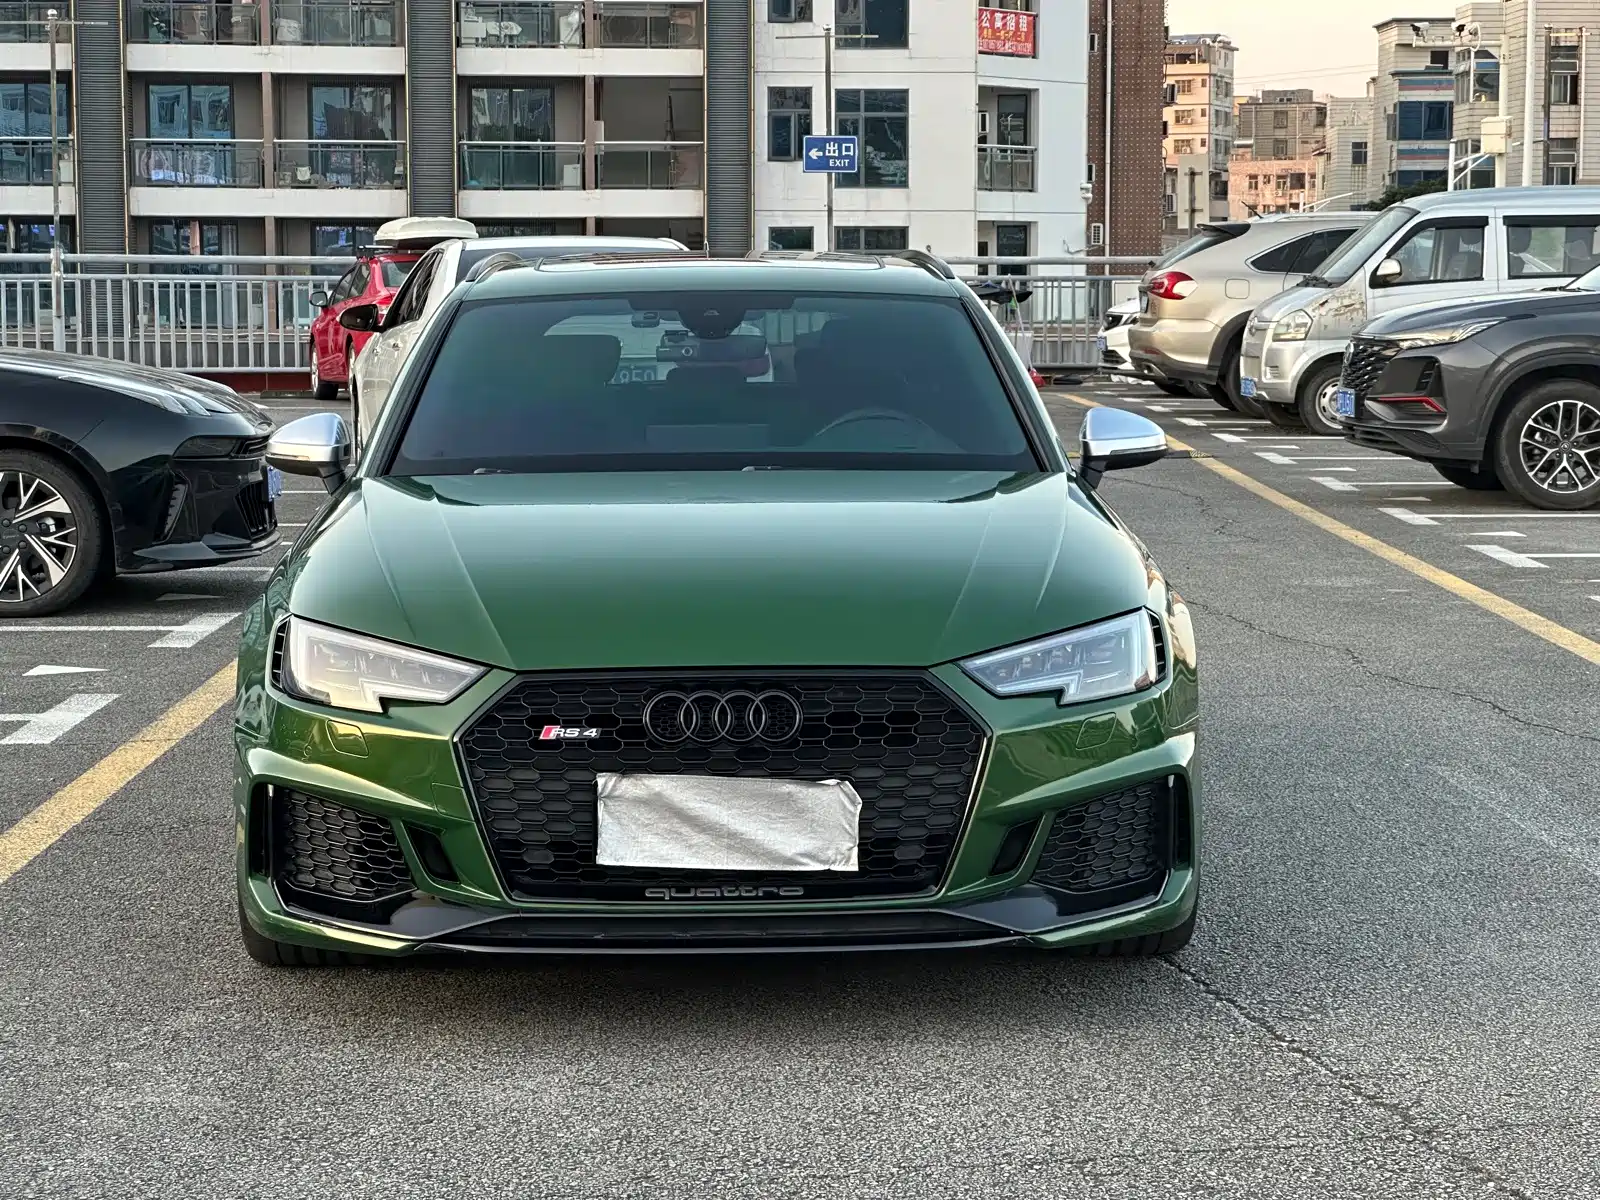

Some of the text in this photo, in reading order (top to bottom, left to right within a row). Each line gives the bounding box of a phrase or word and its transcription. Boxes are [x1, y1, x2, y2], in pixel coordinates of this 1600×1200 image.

[982, 11, 1028, 31] 公寓招租
[825, 142, 854, 157] 出口
[829, 159, 850, 167] EXIT
[545, 726, 598, 739] RS 4
[644, 886, 804, 900] quattro
